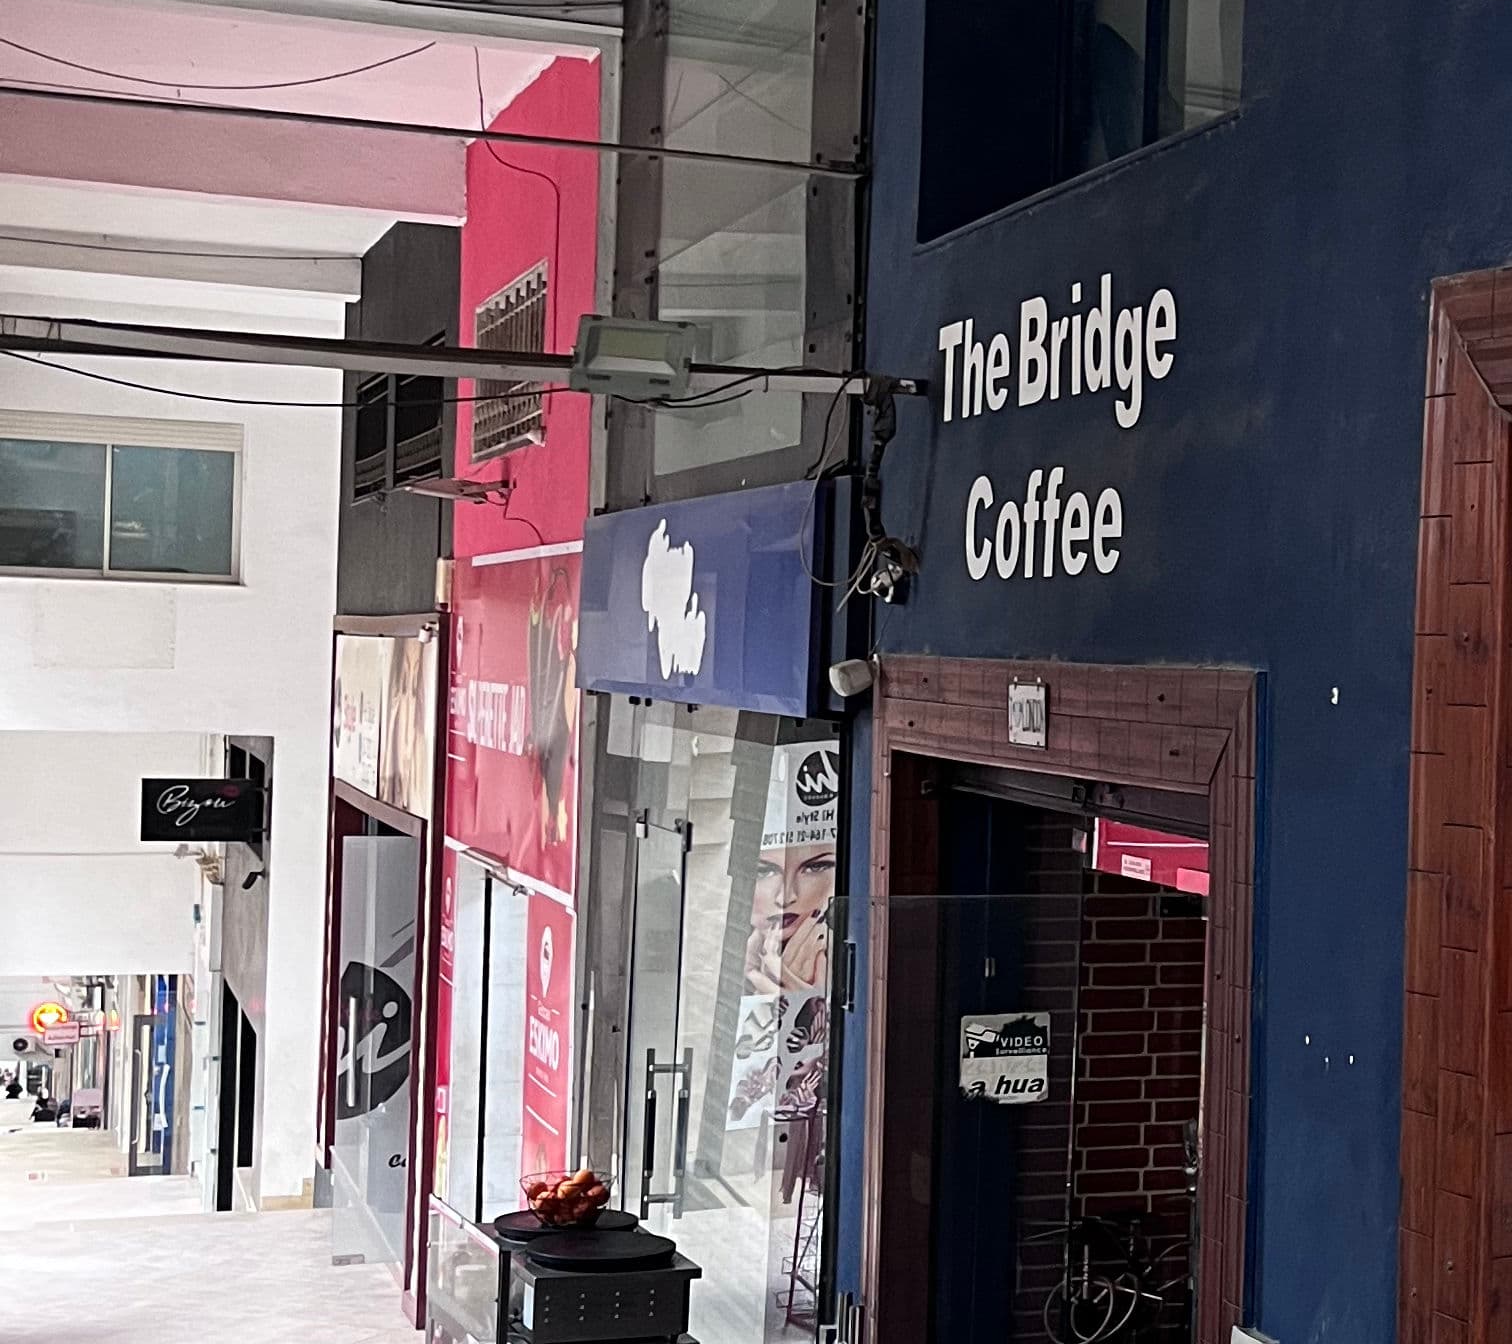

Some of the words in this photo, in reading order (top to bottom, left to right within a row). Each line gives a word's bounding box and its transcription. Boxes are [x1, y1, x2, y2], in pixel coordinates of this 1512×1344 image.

[939, 318, 1010, 422] The
[1018, 273, 1176, 428] Bridge
[965, 467, 1122, 581] Coffee
[1001, 1036, 1044, 1047] VIDEO
